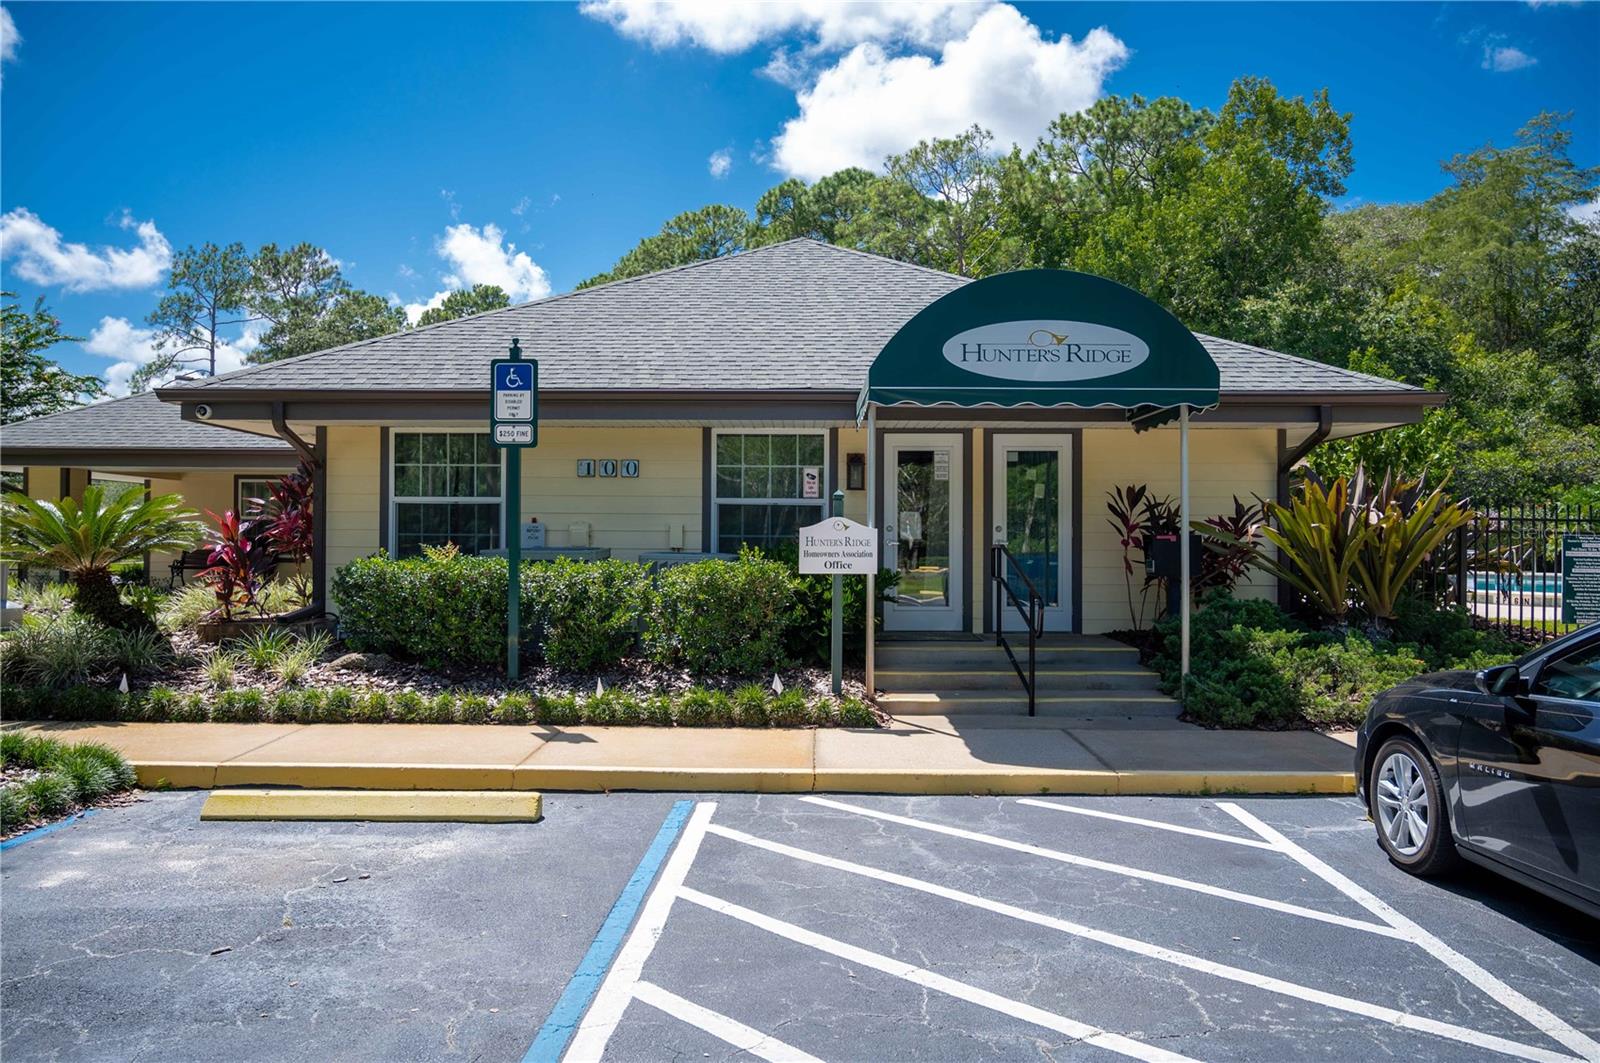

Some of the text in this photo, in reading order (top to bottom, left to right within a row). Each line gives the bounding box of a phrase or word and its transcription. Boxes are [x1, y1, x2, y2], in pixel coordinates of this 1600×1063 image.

[959, 343, 1132, 363] HUNTER'S RIDGE
[583, 462, 637, 475] 100
[805, 536, 872, 547] HUNTER'S RIDGE
[803, 550, 873, 558] Homeowners Association
[824, 560, 853, 570] Office
